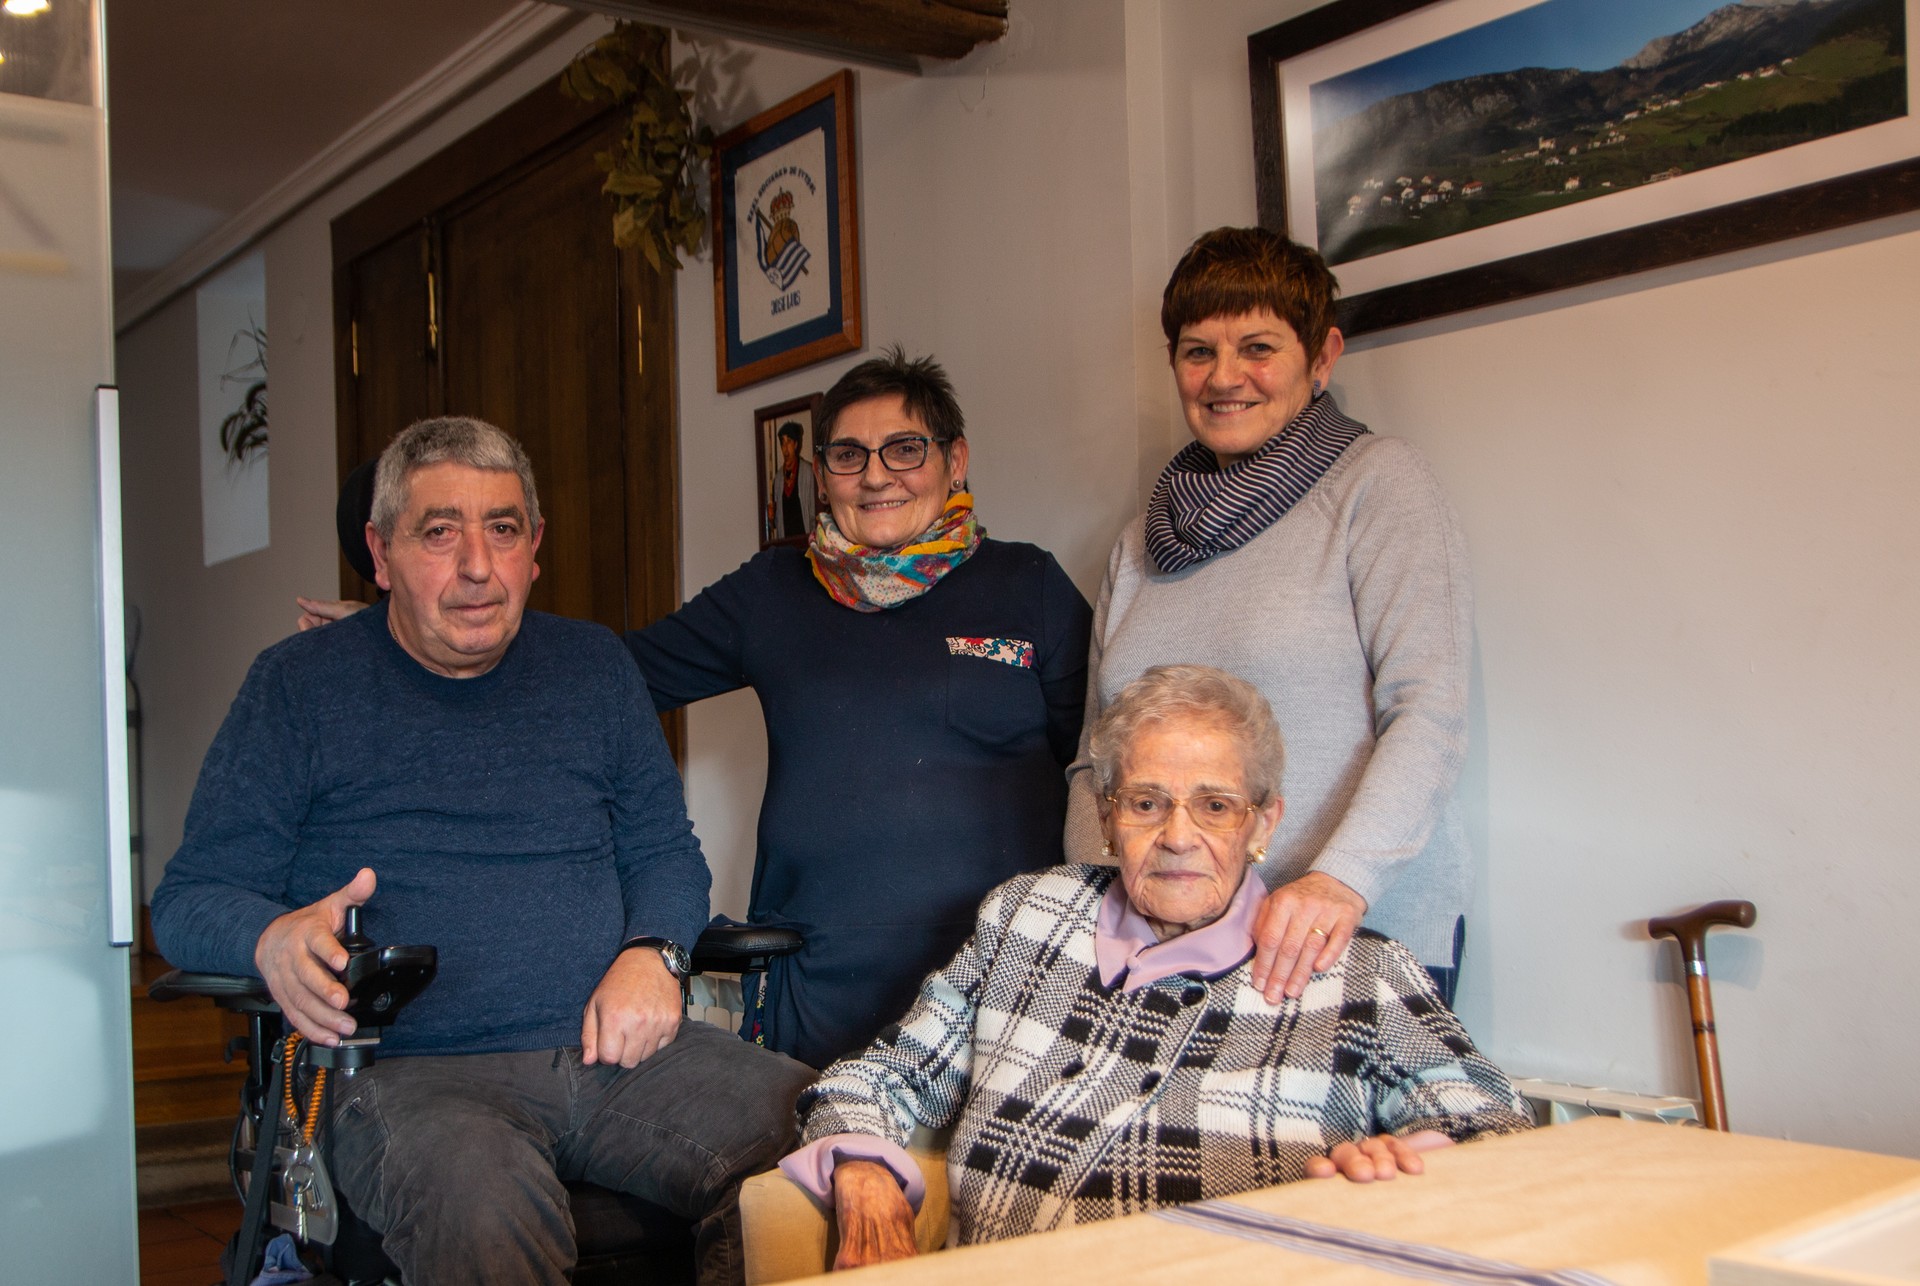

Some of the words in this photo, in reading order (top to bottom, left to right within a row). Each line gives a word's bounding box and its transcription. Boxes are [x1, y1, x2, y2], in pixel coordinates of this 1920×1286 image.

[747, 197, 759, 223] REAL
[789, 166, 797, 175] DE
[771, 296, 785, 315] JOSE
[787, 290, 800, 310] LUIS
